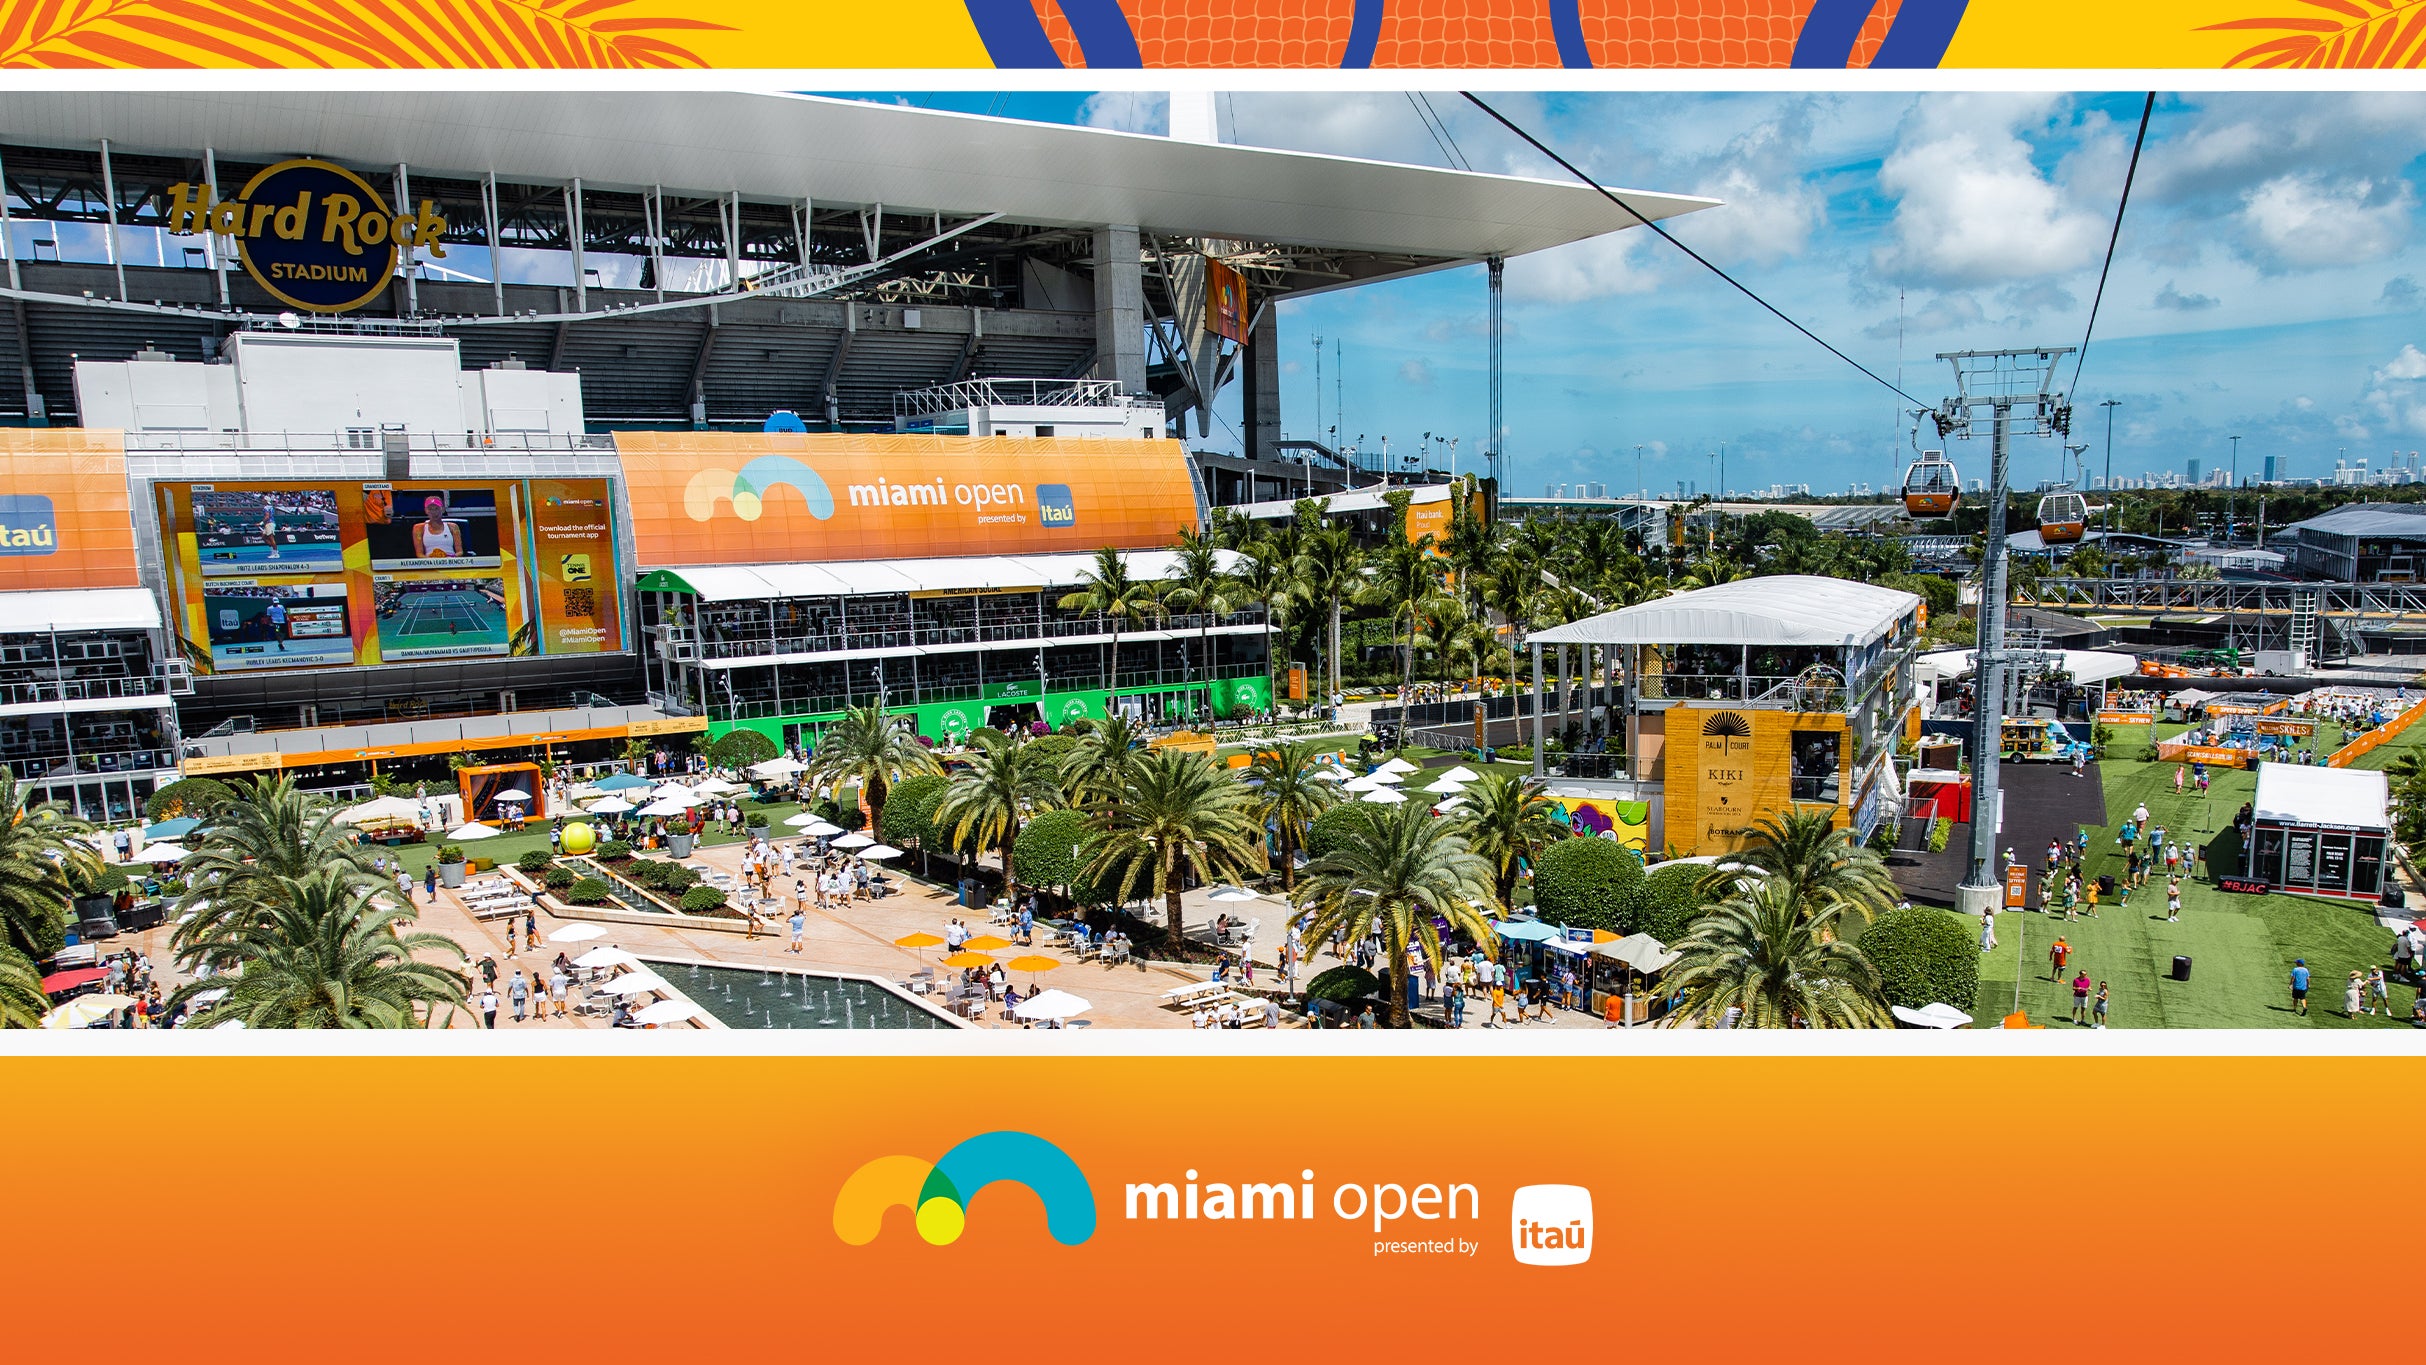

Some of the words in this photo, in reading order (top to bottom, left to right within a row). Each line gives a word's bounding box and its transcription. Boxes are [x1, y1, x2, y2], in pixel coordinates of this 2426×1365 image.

[168, 182, 312, 241] Hard
[321, 193, 447, 258] Rock
[271, 262, 368, 283] STADIUM
[848, 477, 948, 507] miami
[954, 483, 1025, 512] open
[978, 513, 1016, 525] presented
[1016, 514, 1026, 524] by
[1041, 504, 1073, 522] Itaú
[0, 524, 53, 547] taú
[314, 533, 336, 541] betway
[222, 616, 238, 627] Itaú
[560, 627, 606, 637] @MiamiOpen
[998, 690, 1028, 698] LACOSTE
[2280, 724, 2306, 735] SKILLS
[1730, 742, 1750, 750] COURT
[1709, 770, 1743, 780] KIKI
[2279, 820, 2360, 832] www.Barrett-Jackson.com
[2222, 880, 2266, 894] #BJAC
